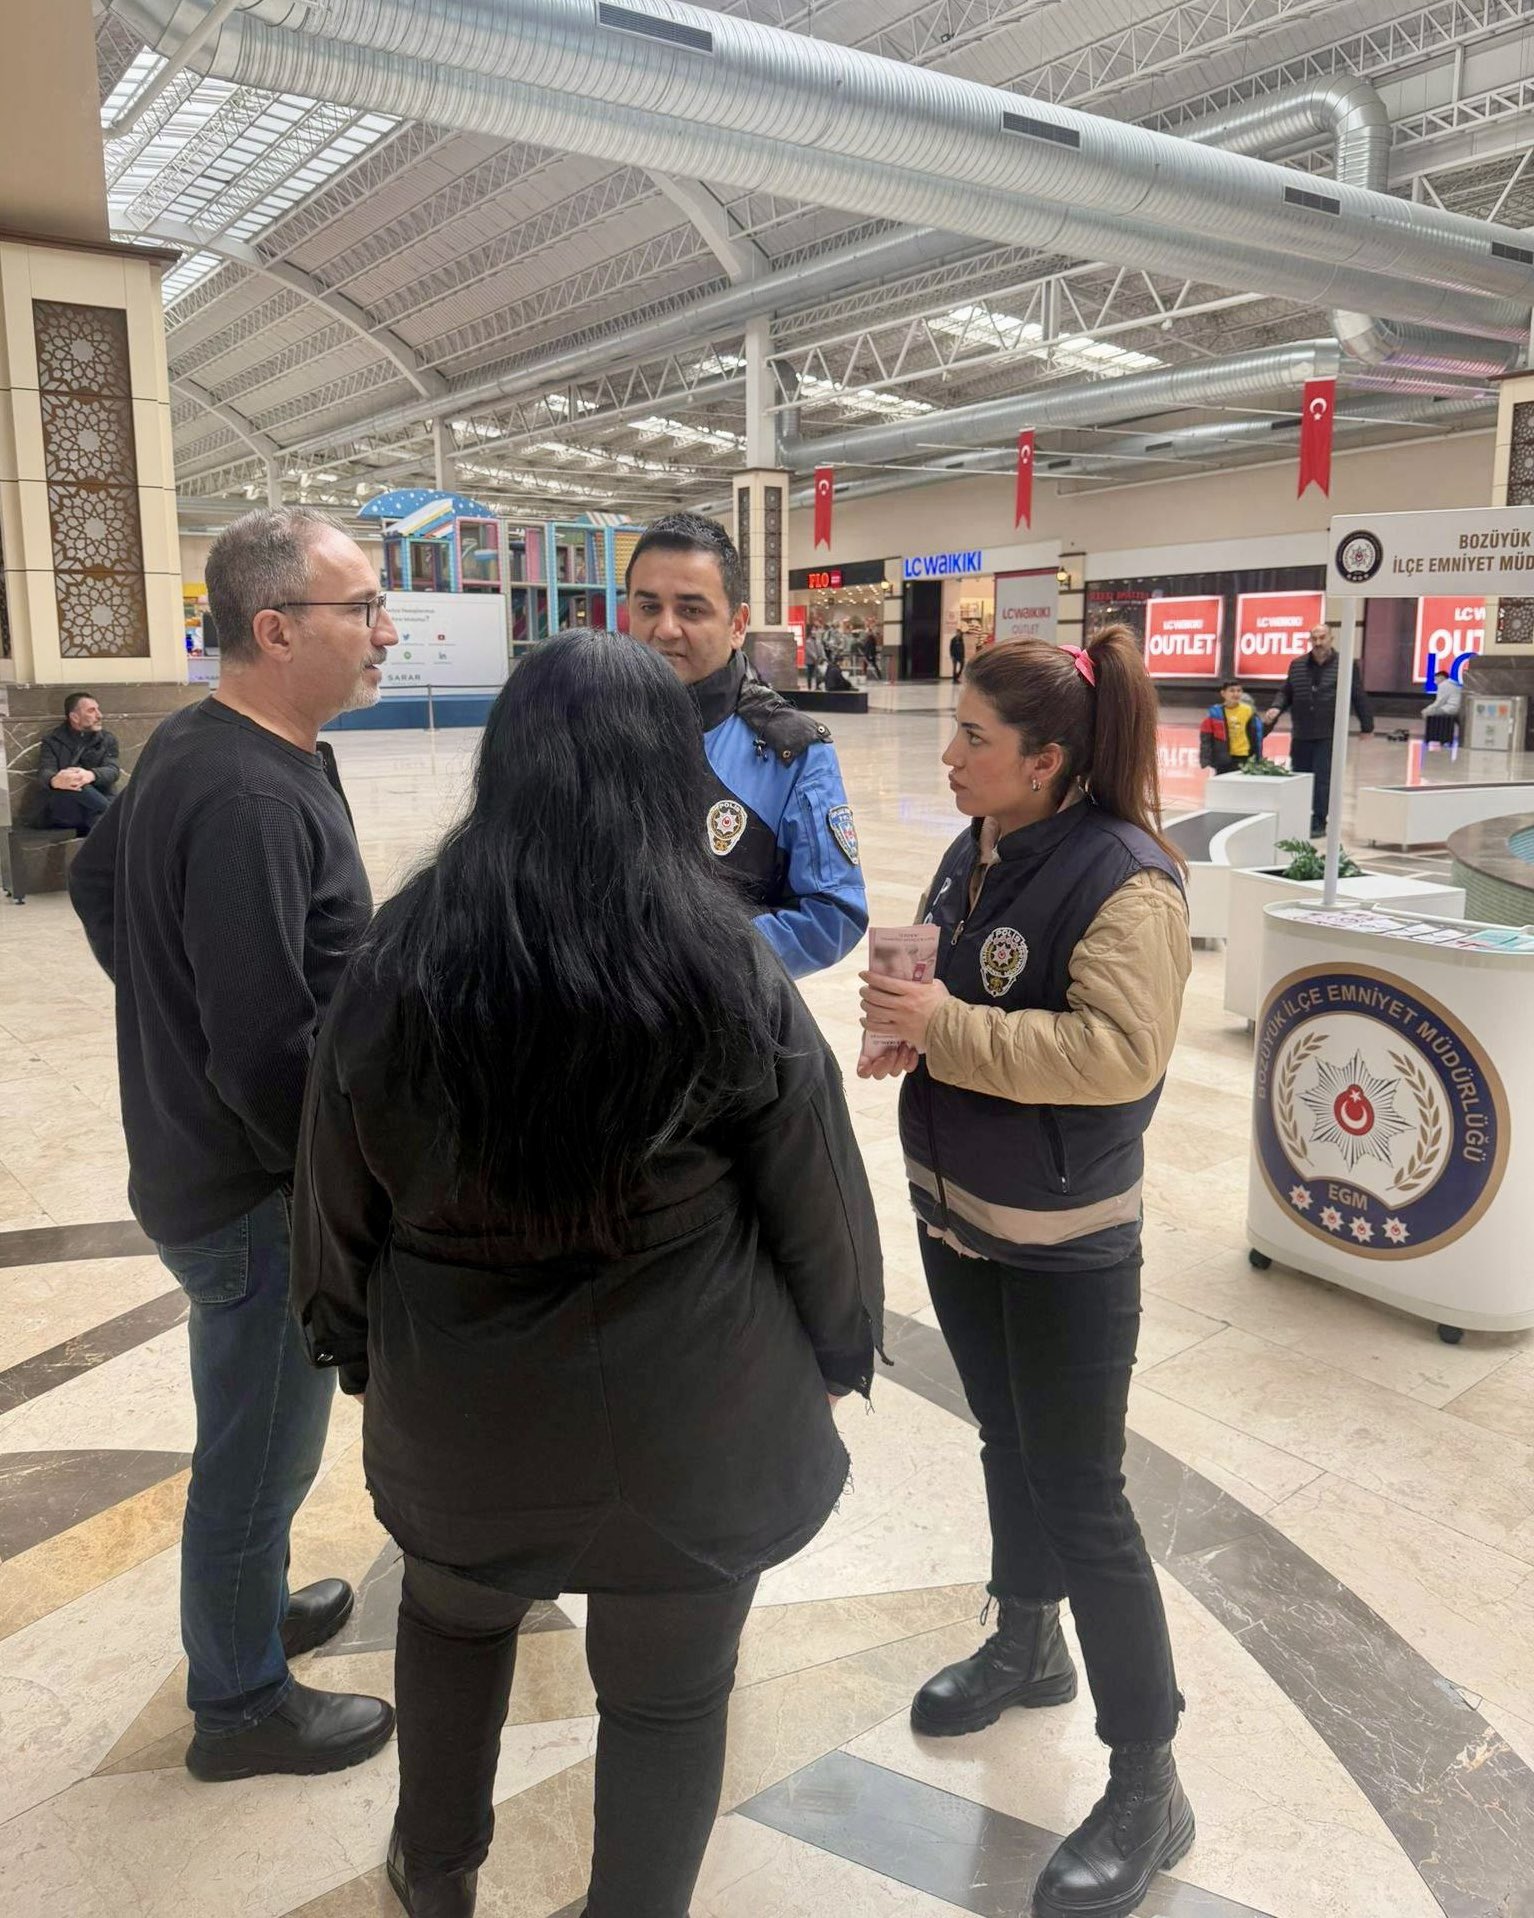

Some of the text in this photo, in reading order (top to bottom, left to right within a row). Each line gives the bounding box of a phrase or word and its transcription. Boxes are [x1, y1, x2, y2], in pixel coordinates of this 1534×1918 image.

[1459, 528, 1532, 550] BOZÜYÜK
[1392, 555, 1424, 577] İLÇE
[1428, 553, 1495, 573] EMNİYET
[1149, 633, 1216, 656] OUTLET
[1283, 987, 1324, 1017] İLÇE
[1327, 984, 1419, 1025] EMNİYET
[1415, 1021, 1490, 1163] MÜDÜRLÜĞÜ
[1328, 1183, 1368, 1211] EGM
